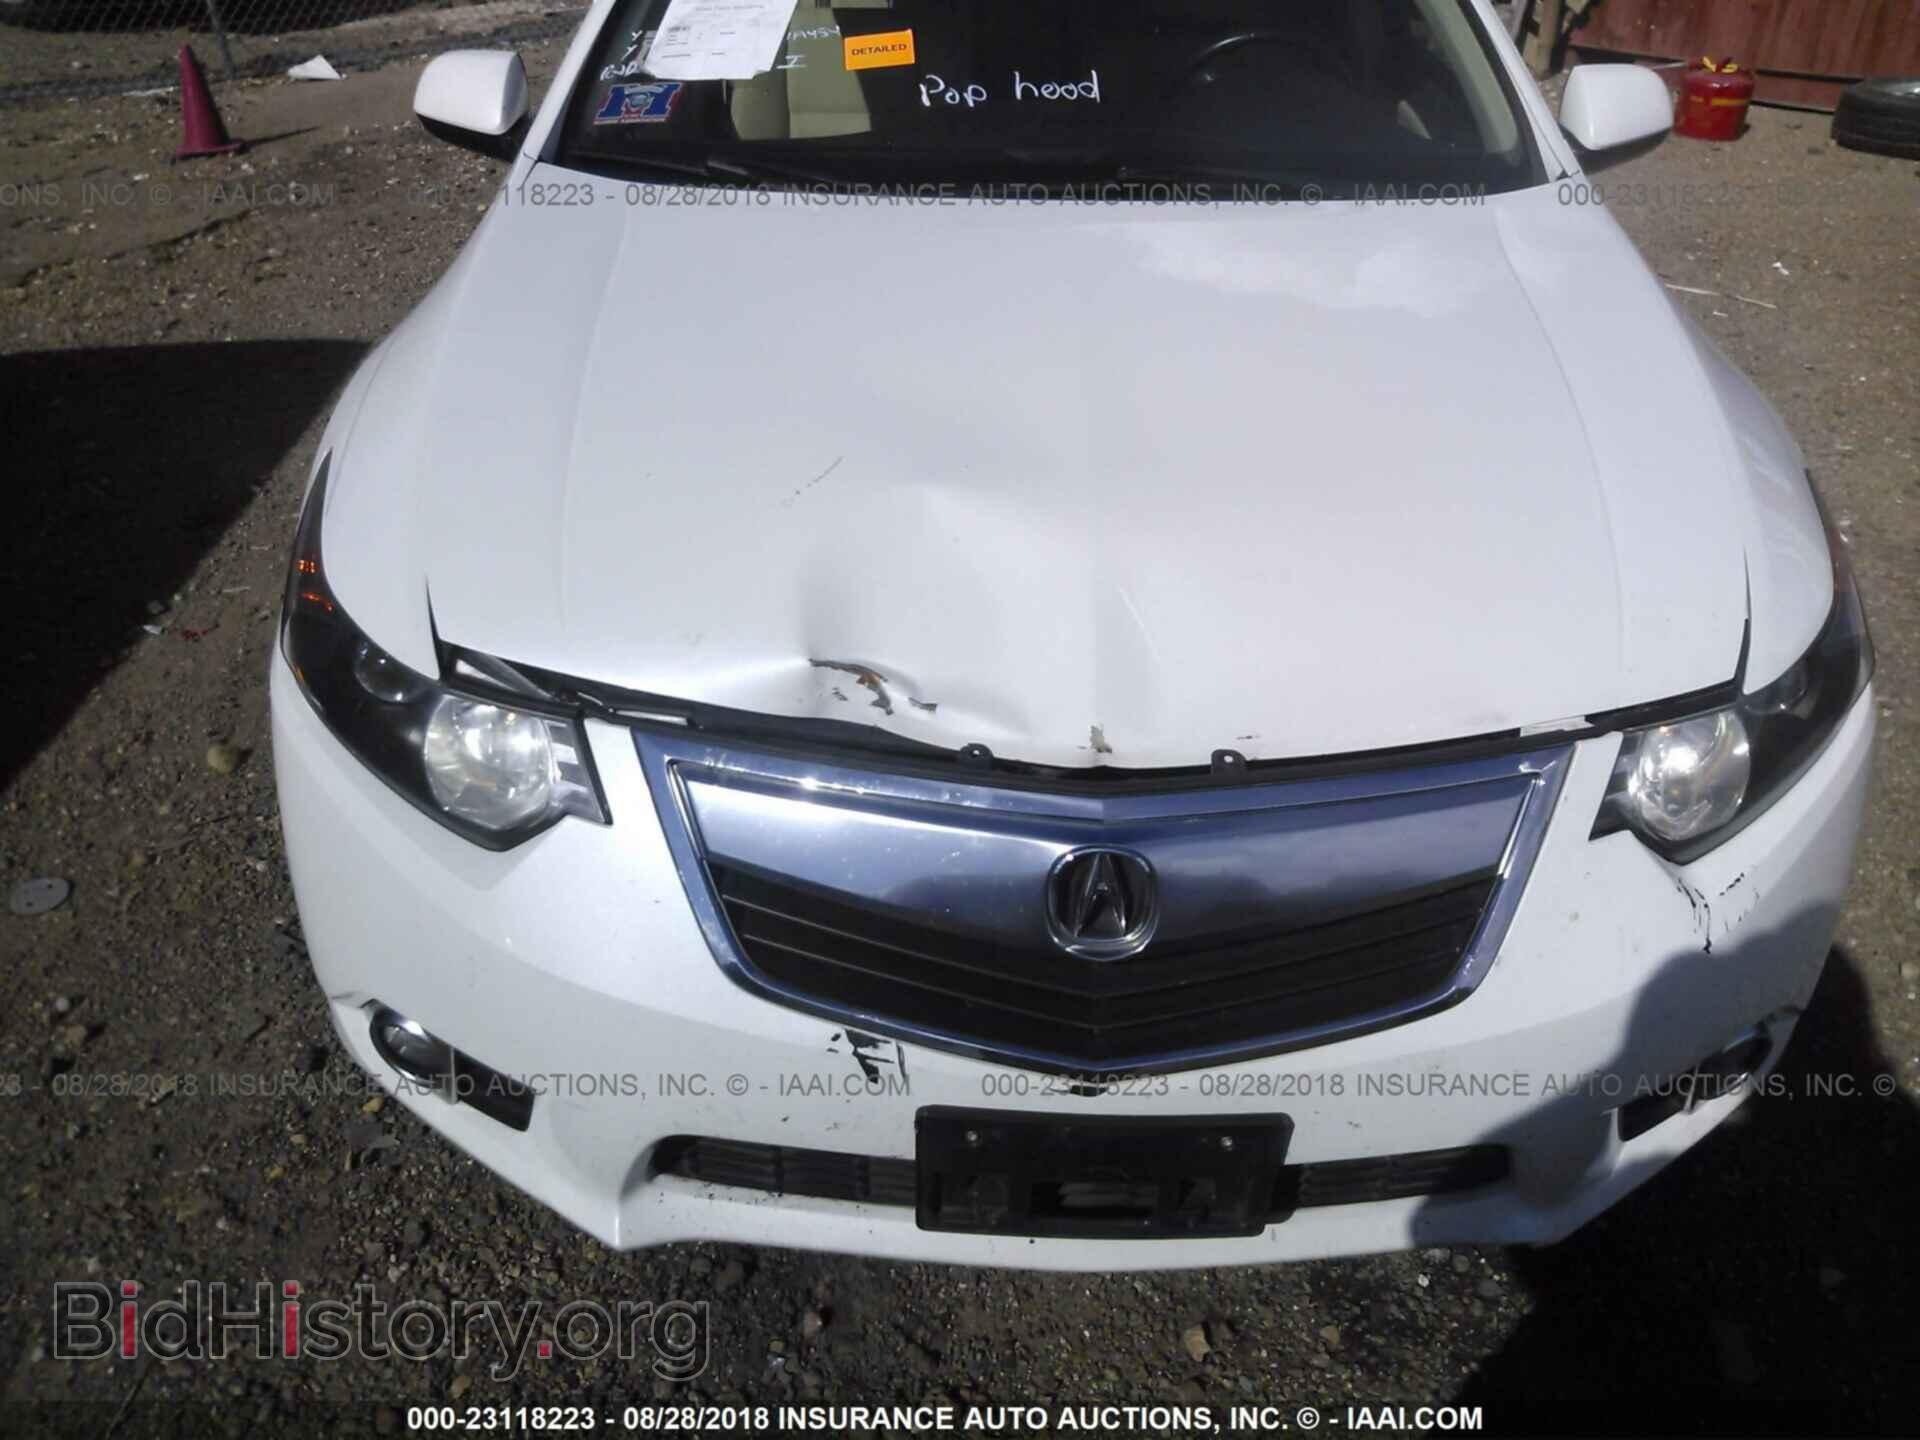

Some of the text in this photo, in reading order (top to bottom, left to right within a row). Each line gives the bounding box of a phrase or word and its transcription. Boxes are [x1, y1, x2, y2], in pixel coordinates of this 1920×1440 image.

[851, 43, 907, 56] DETAILED
[919, 69, 1101, 107] Pop hood
